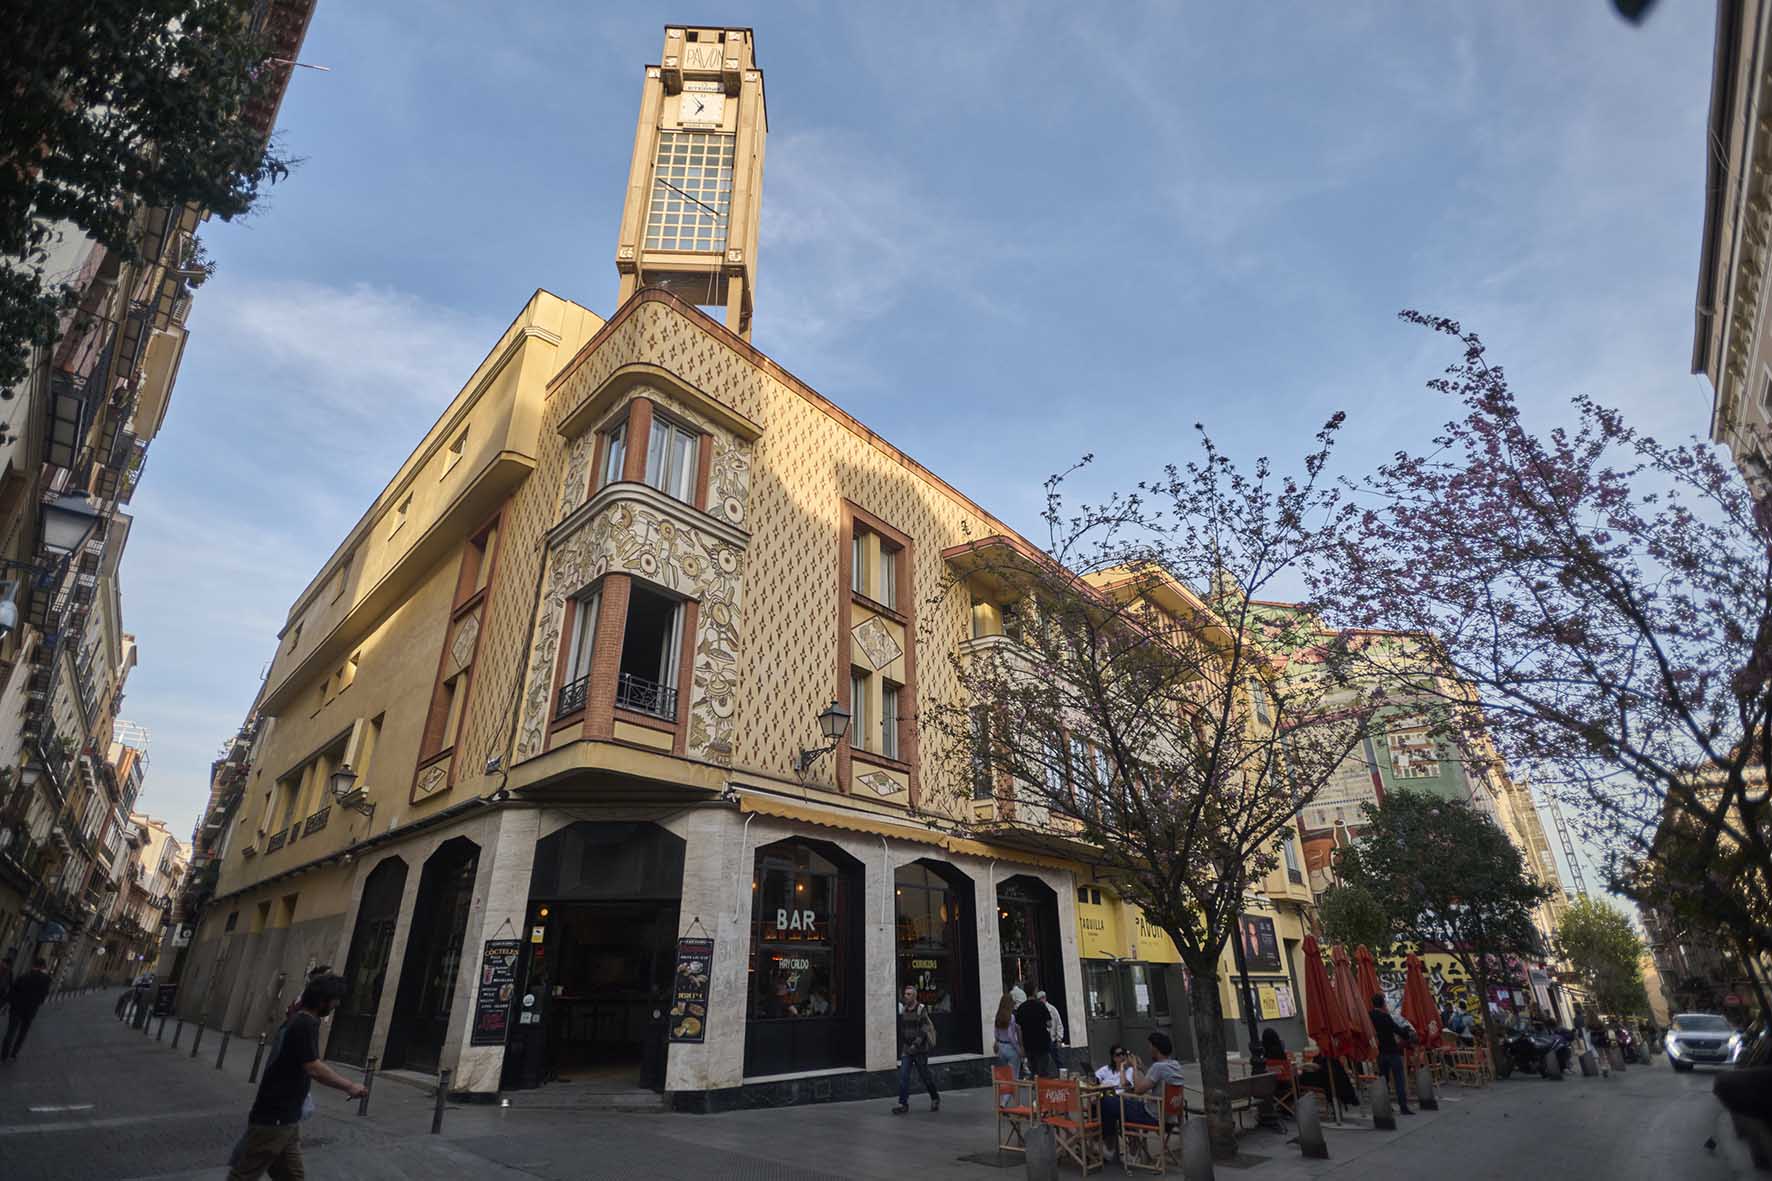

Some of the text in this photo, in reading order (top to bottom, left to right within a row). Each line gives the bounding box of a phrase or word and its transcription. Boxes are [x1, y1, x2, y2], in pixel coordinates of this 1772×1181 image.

[776, 908, 816, 931] BAR
[1079, 917, 1104, 931] TAQUILLA
[778, 959, 809, 969] HAY CALDO
